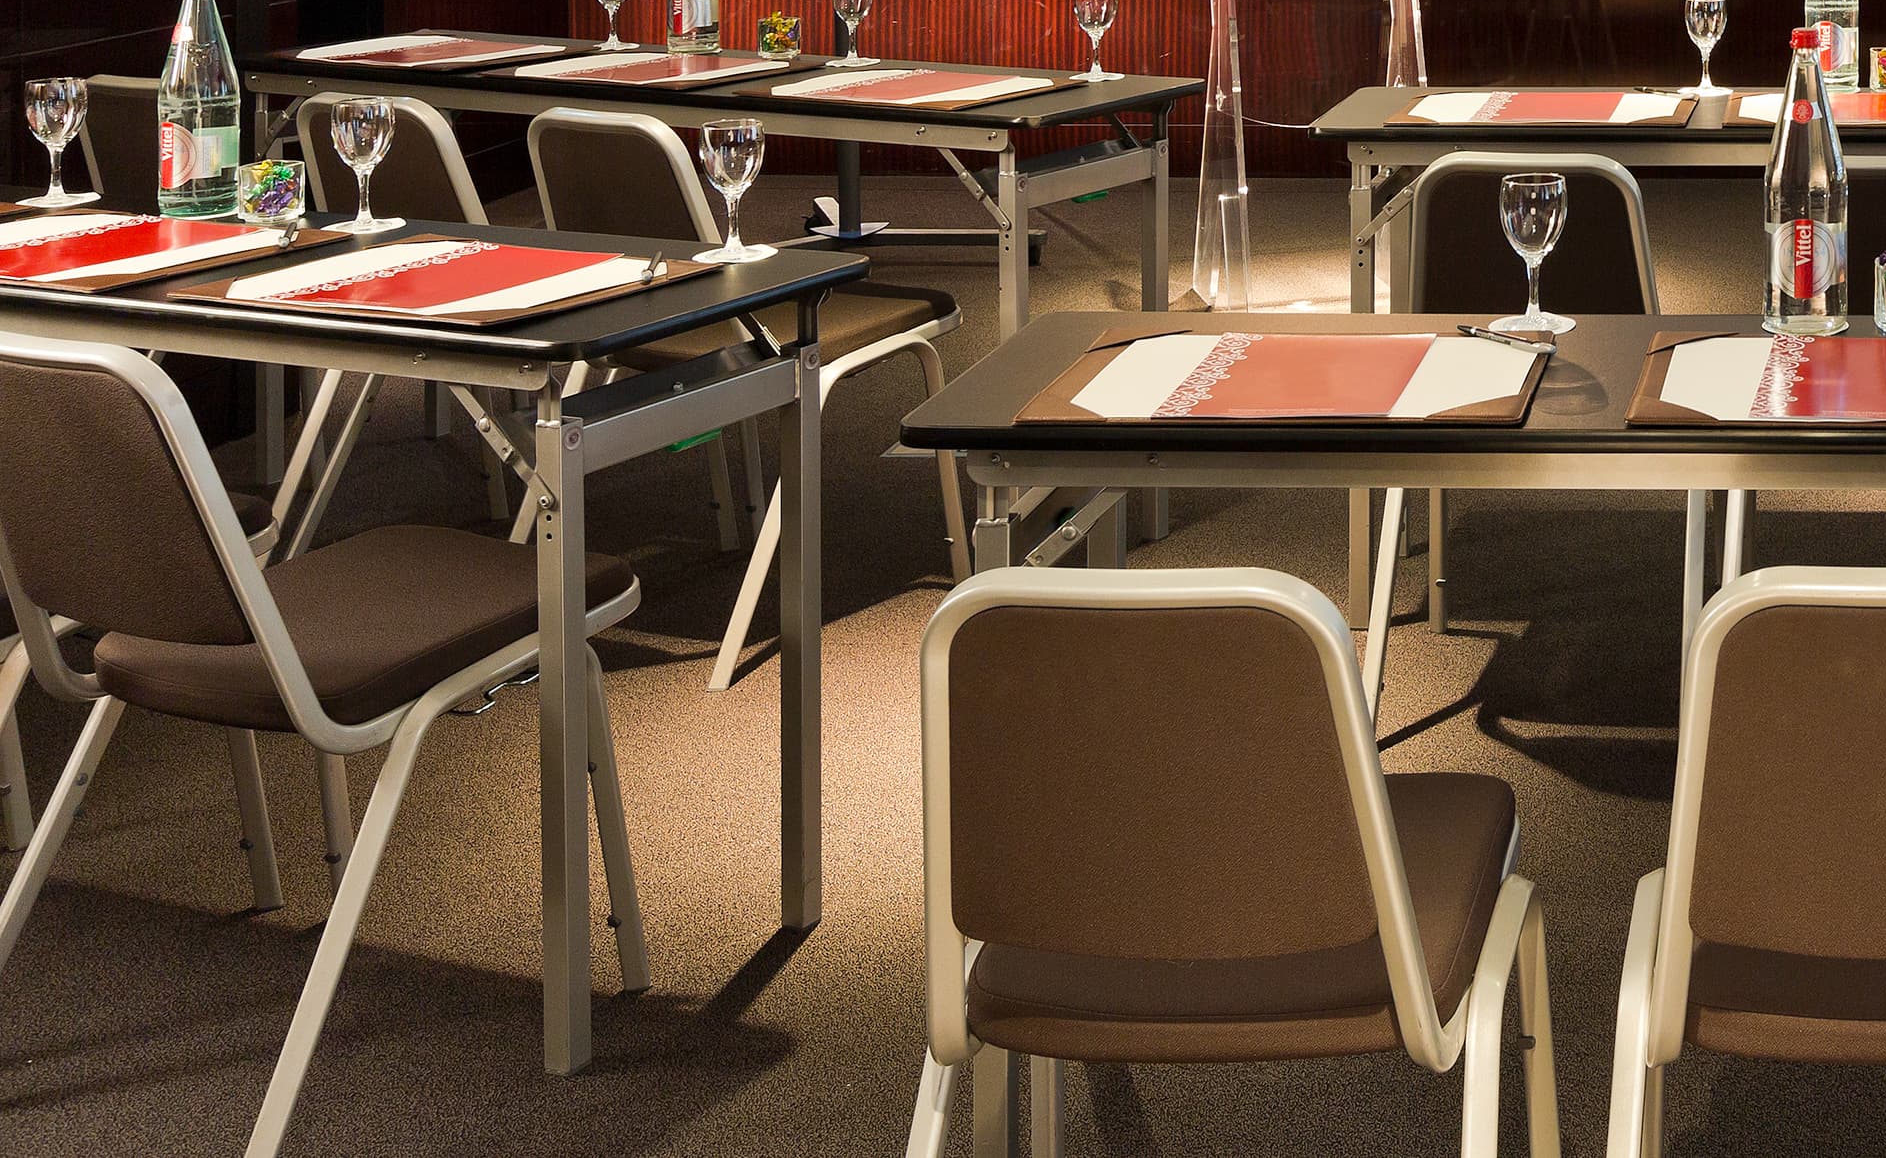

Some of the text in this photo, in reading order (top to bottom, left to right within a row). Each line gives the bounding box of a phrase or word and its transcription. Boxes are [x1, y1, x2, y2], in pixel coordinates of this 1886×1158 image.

[1820, 26, 1831, 52] Vittel
[161, 127, 173, 161] Vittel
[1796, 225, 1812, 267] Vittel
